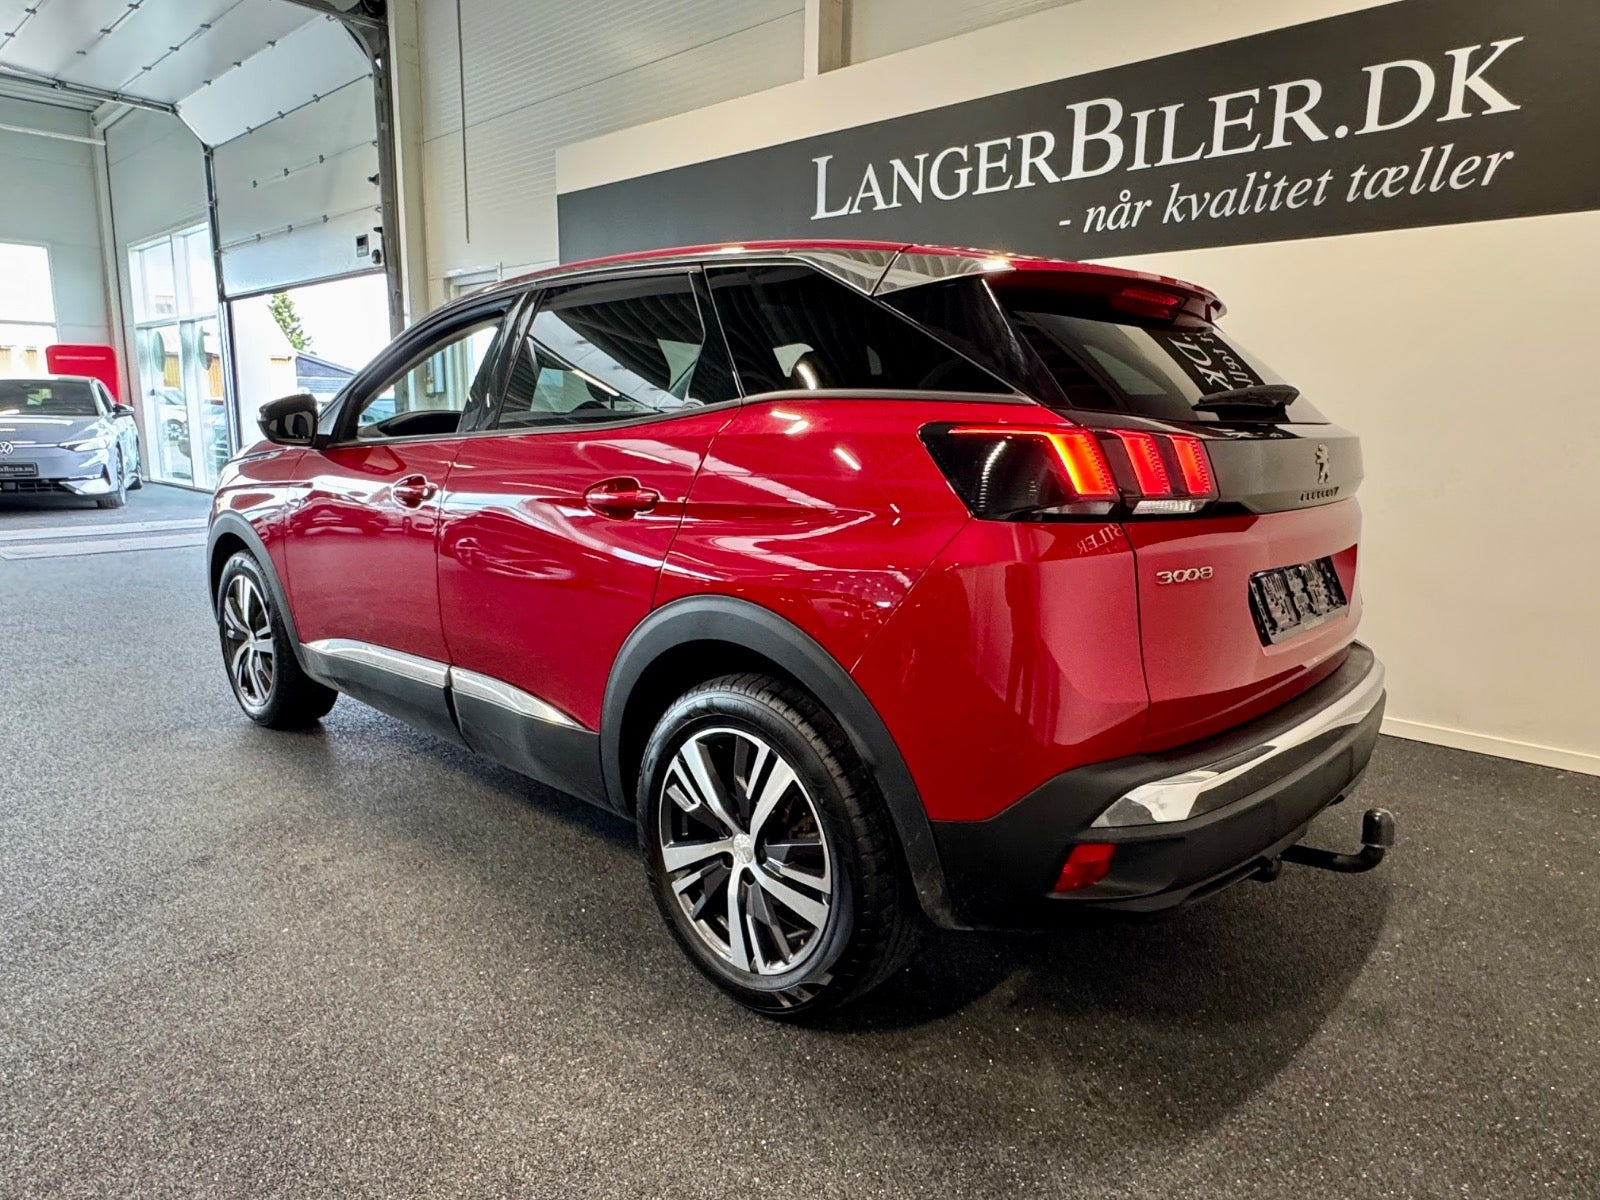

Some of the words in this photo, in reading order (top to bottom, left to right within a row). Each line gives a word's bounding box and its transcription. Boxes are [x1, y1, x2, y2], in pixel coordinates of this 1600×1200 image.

[810, 36, 1525, 221] LANGERBILER.DK
[1083, 189, 1153, 233] når
[1162, 169, 1334, 224] kvalitet
[1346, 143, 1515, 203] tæller
[1155, 566, 1214, 585] 3008
